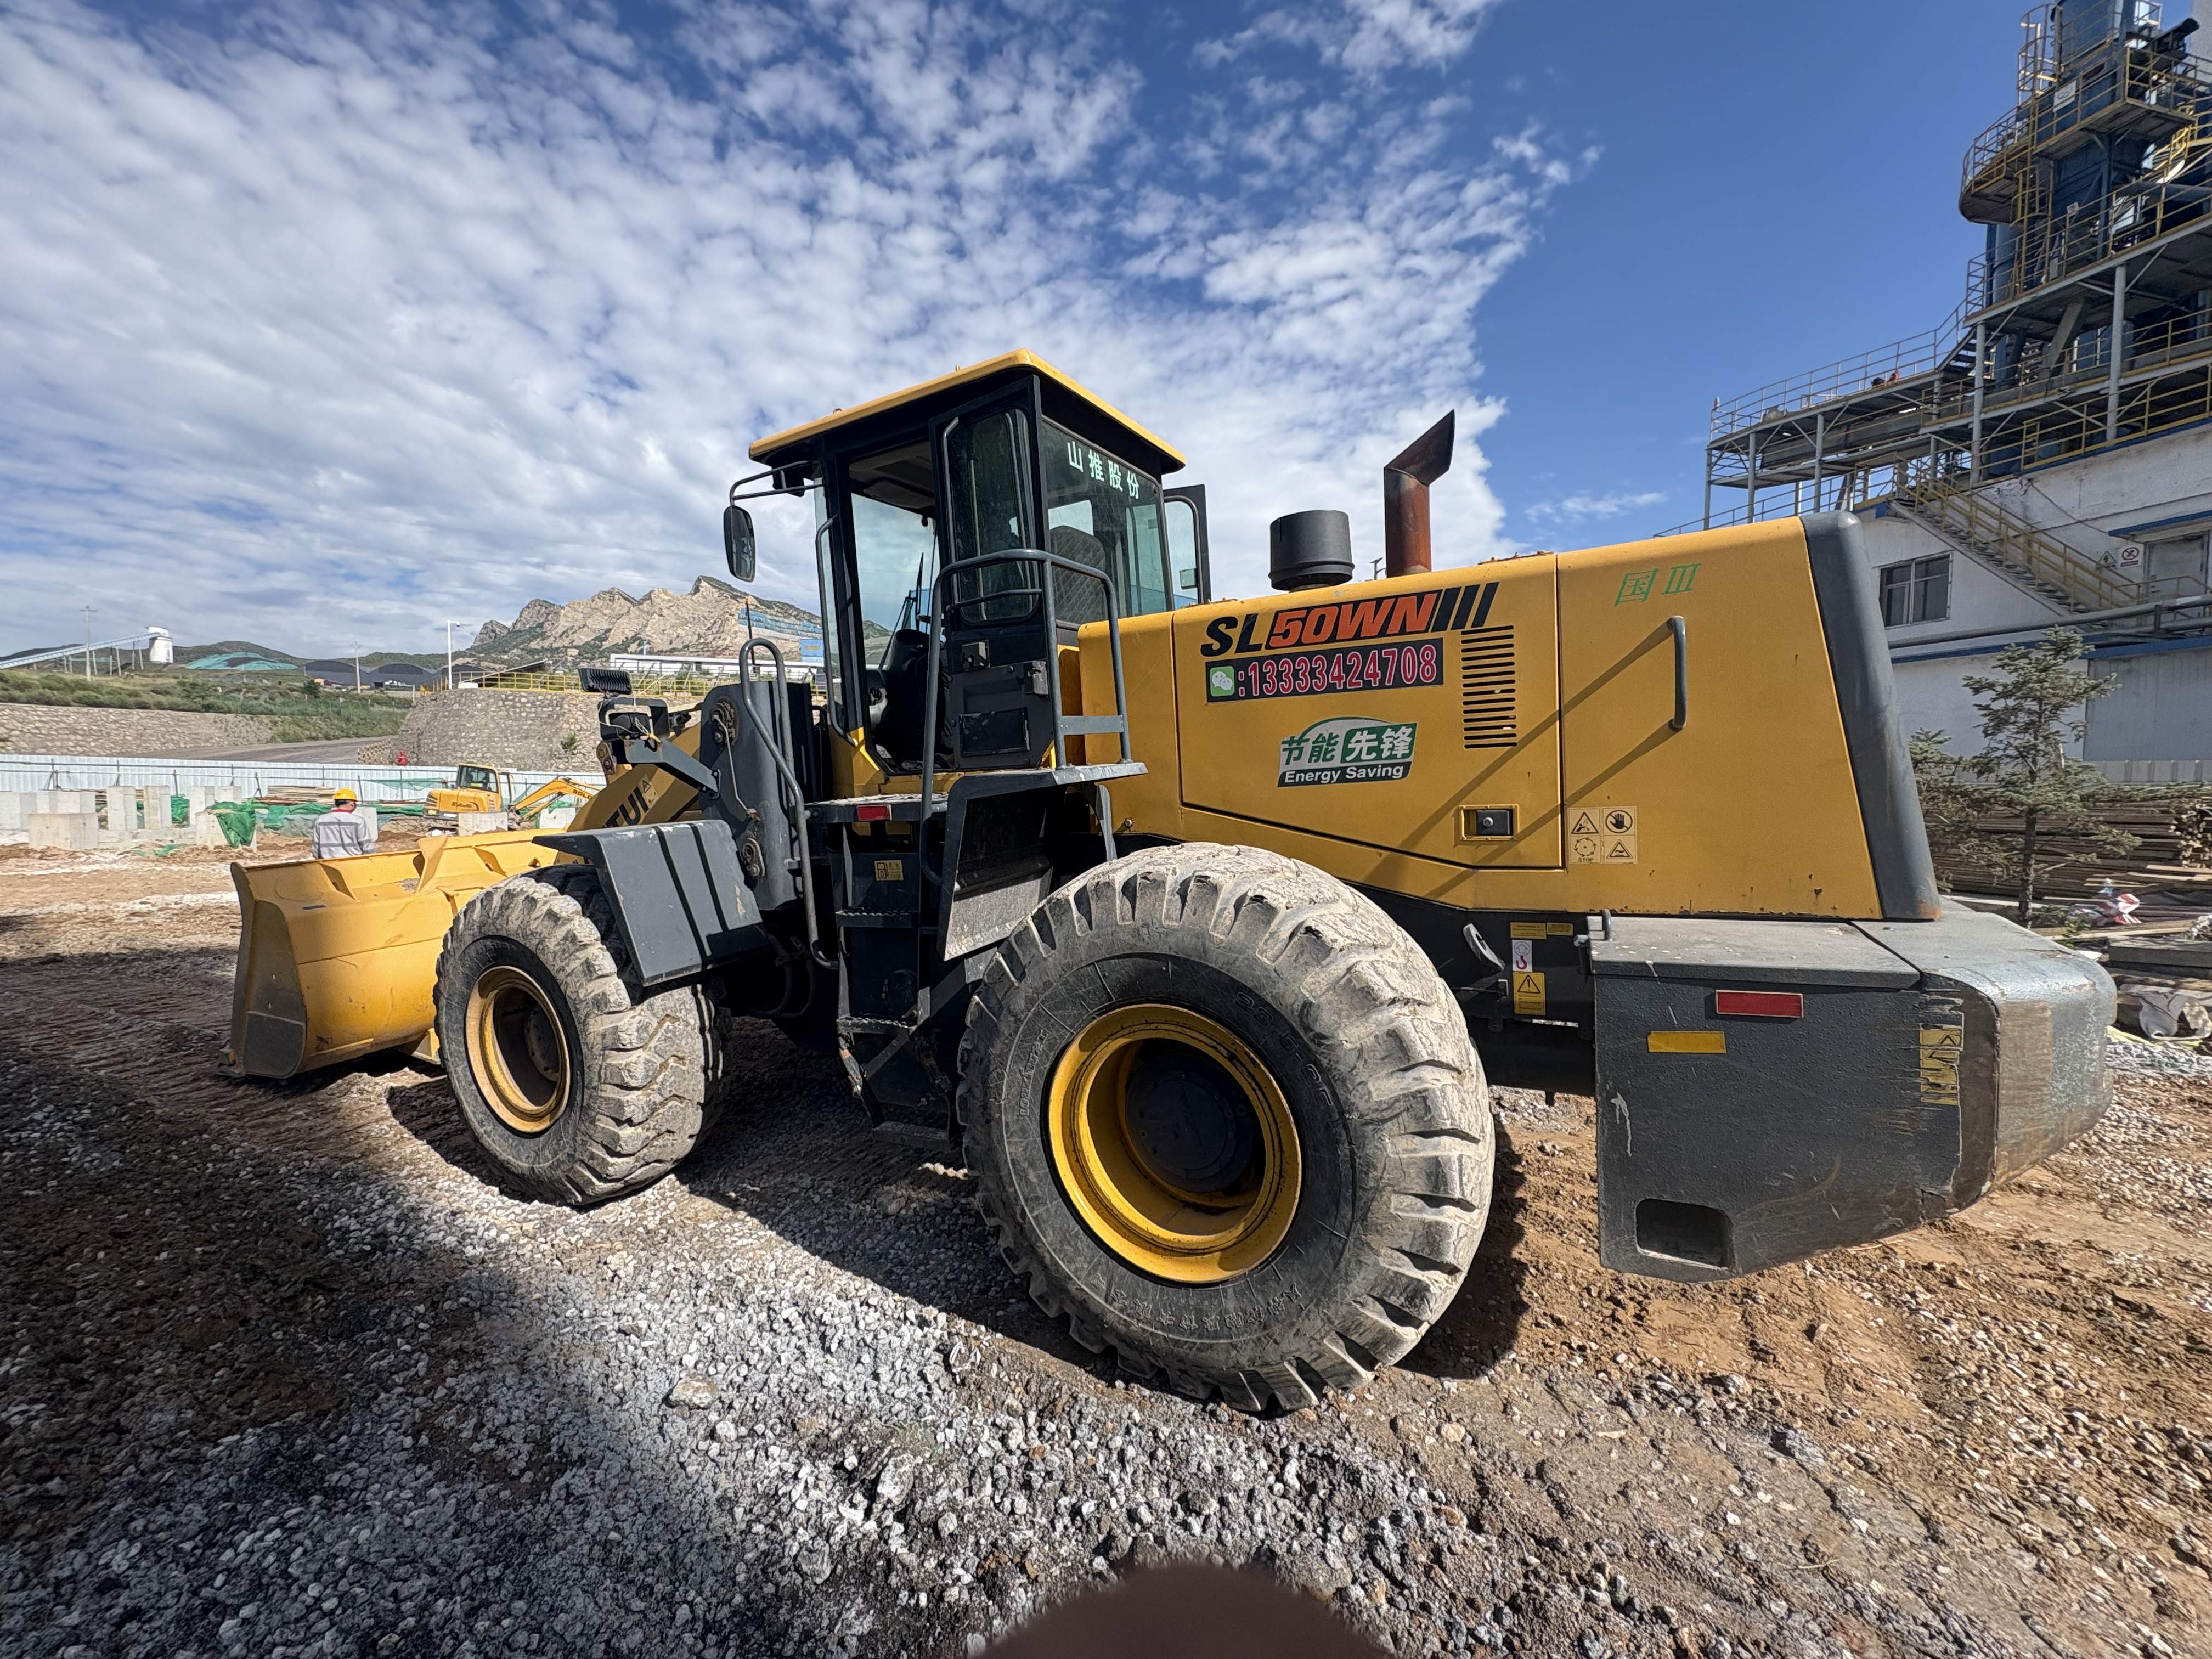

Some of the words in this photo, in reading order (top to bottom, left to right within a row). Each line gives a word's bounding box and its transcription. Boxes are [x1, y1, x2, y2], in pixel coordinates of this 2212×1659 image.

[1067, 441, 1139, 499] 山推股份
[1200, 592, 1441, 657] SL50WN
[1280, 726, 1414, 766] 节能先锋
[1284, 769, 1340, 785] Energy
[1345, 765, 1404, 781] Saving
[601, 786, 650, 828] TUI
